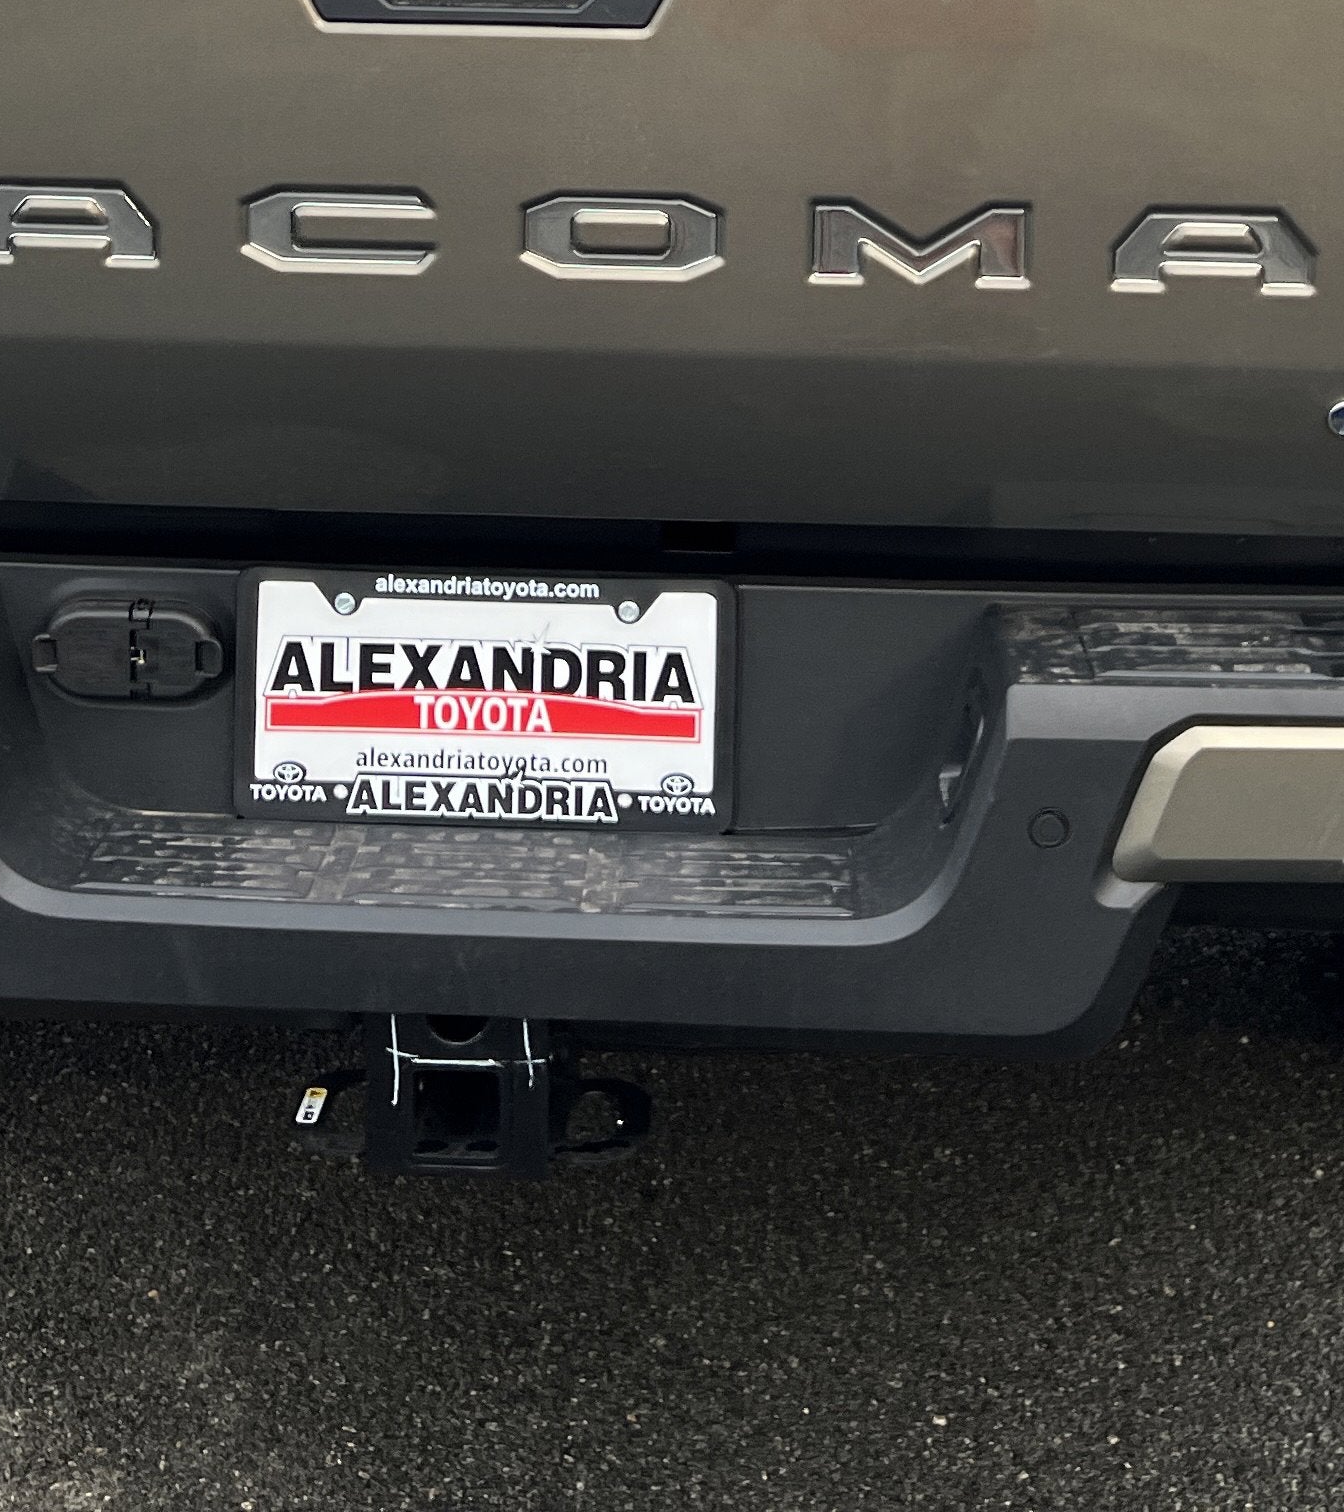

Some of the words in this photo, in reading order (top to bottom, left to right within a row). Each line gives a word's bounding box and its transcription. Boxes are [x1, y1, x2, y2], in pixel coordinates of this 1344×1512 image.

[375, 574, 600, 601] alexandriatoyota.com
[270, 640, 696, 705] ALEXANDRIA
[413, 695, 553, 732] TOYOTA
[355, 745, 609, 776] alexandriatoyota.com
[250, 783, 327, 804] TOYOTA
[352, 777, 614, 820] ALEXANDRIA
[637, 794, 716, 816] TOYOTA
